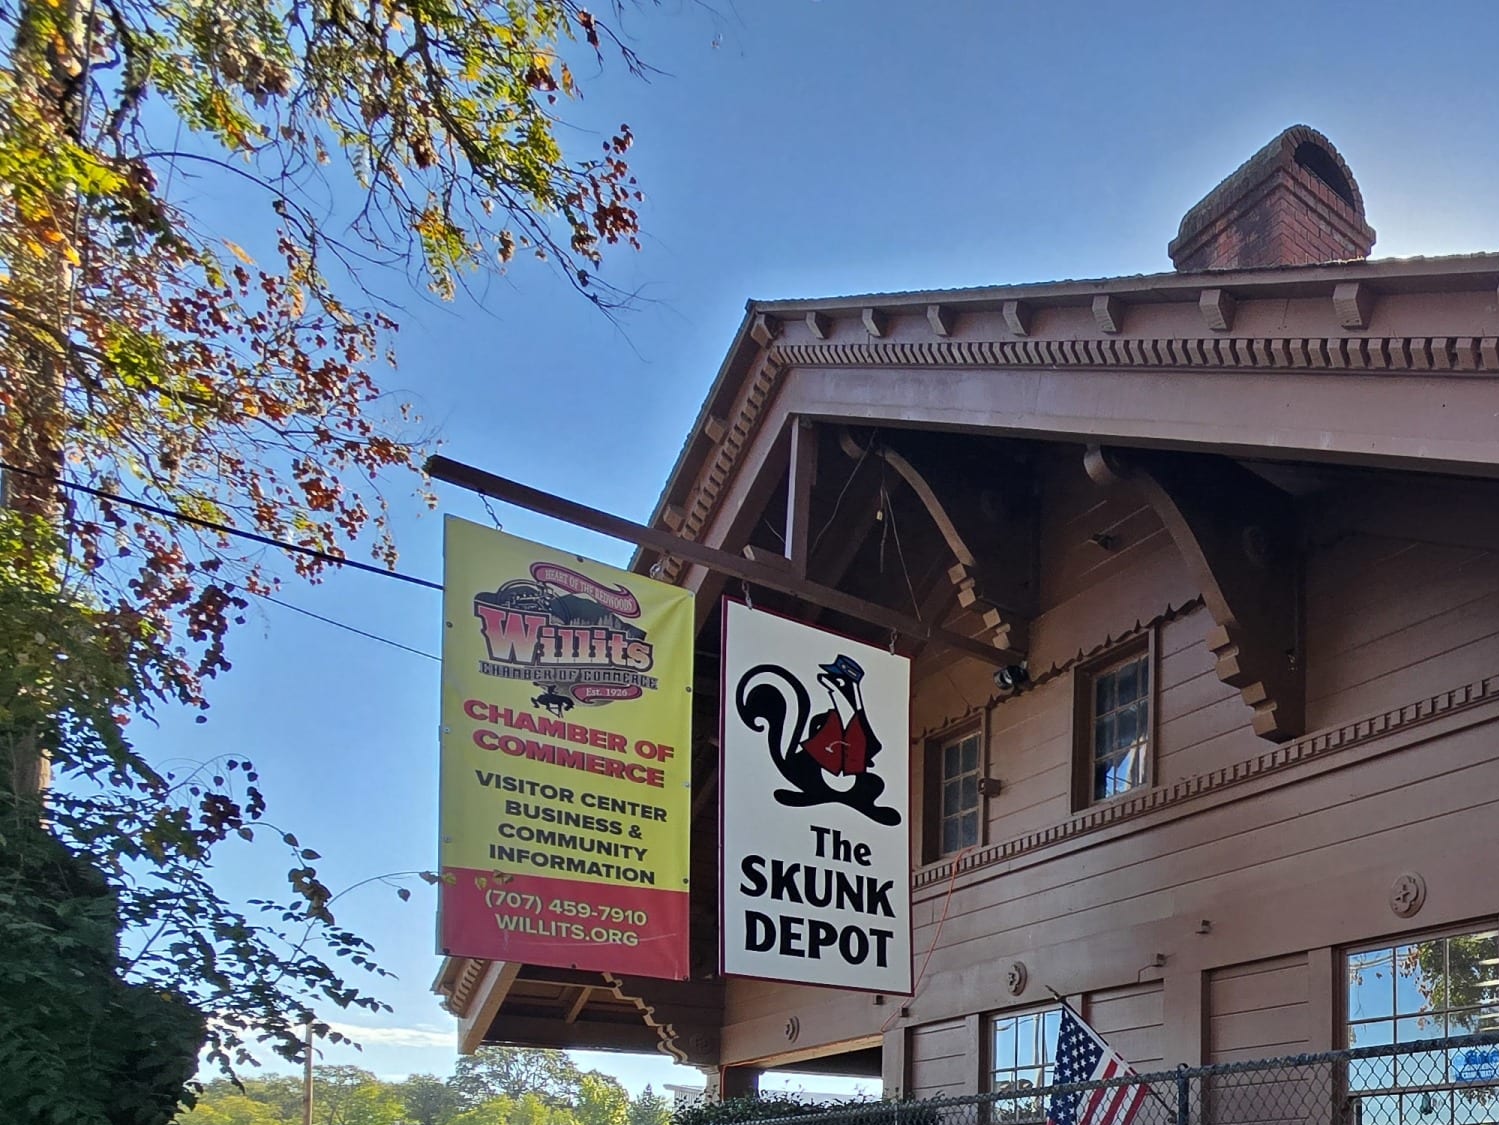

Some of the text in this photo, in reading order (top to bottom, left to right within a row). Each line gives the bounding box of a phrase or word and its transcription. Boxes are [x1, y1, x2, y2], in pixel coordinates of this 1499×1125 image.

[545, 569, 633, 611] HEART OF THE REDWOODS
[476, 605, 651, 670] Willits
[480, 661, 658, 689] CHAMBER OF COMMERCE
[586, 687, 628, 698] Est. 1926
[464, 699, 674, 763] CHAMBER OF
[472, 729, 665, 788] COMMERCE
[475, 770, 667, 822] VISITOR CENTER
[505, 800, 643, 840] BUSINESS &
[498, 823, 648, 862] COMMUNITY
[810, 825, 872, 866] The
[489, 844, 655, 885] INFORMATION
[740, 855, 896, 918] SKUNK
[485, 889, 647, 926] (707) 459-7910
[496, 913, 639, 946] WILLITS.ORG
[745, 910, 894, 968] DEPOT
